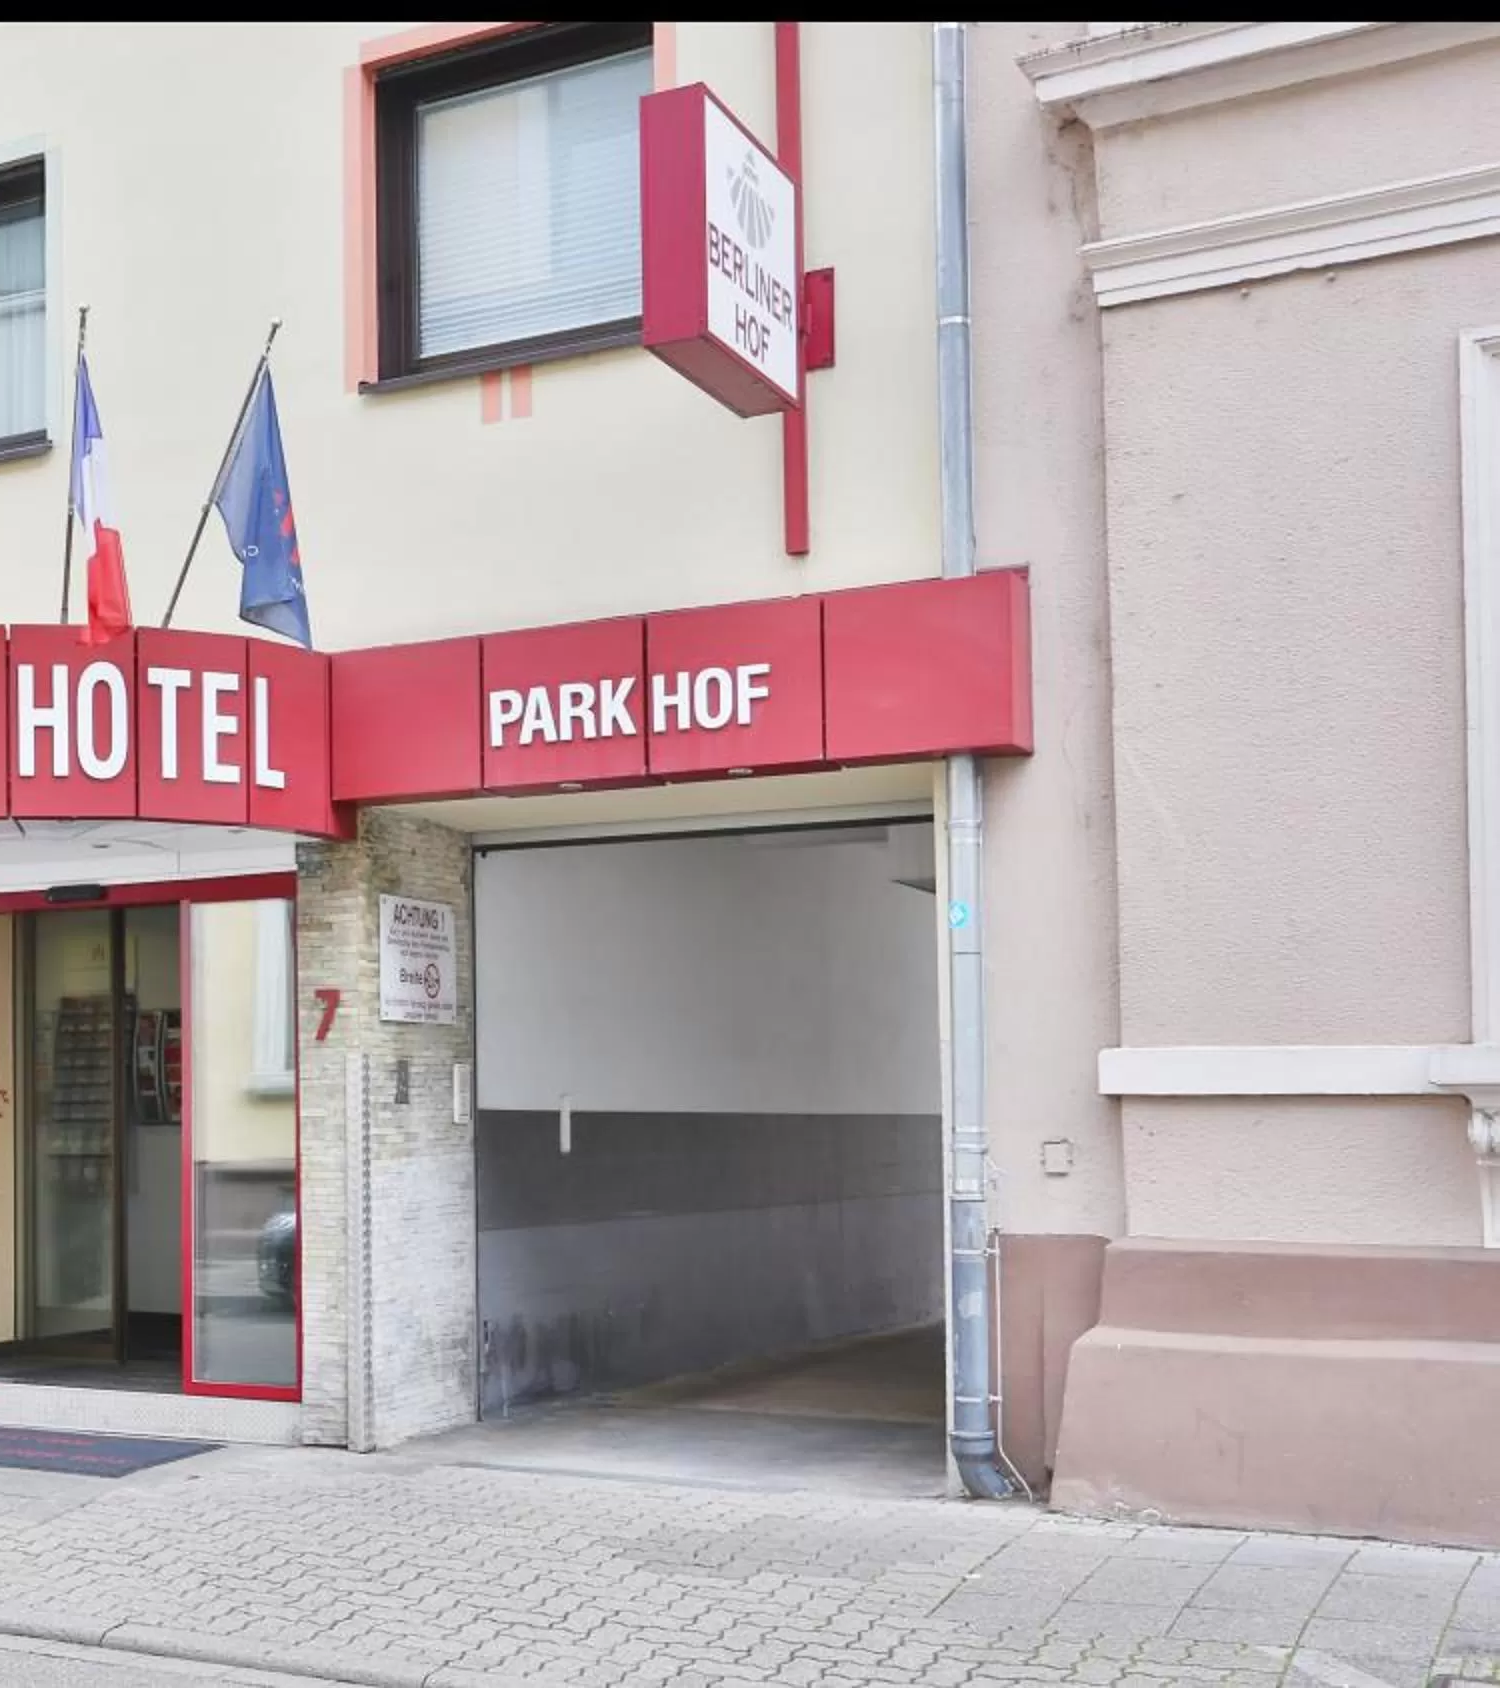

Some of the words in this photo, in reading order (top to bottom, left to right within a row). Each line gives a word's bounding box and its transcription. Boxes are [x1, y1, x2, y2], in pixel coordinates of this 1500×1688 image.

[708, 221, 793, 332] BERLINER
[735, 303, 770, 364] HOF
[17, 661, 285, 789] HOTEL
[489, 677, 637, 747] PARK
[652, 663, 771, 734] HOF
[394, 903, 439, 930] ACHTUNG
[314, 989, 341, 1041] 7
